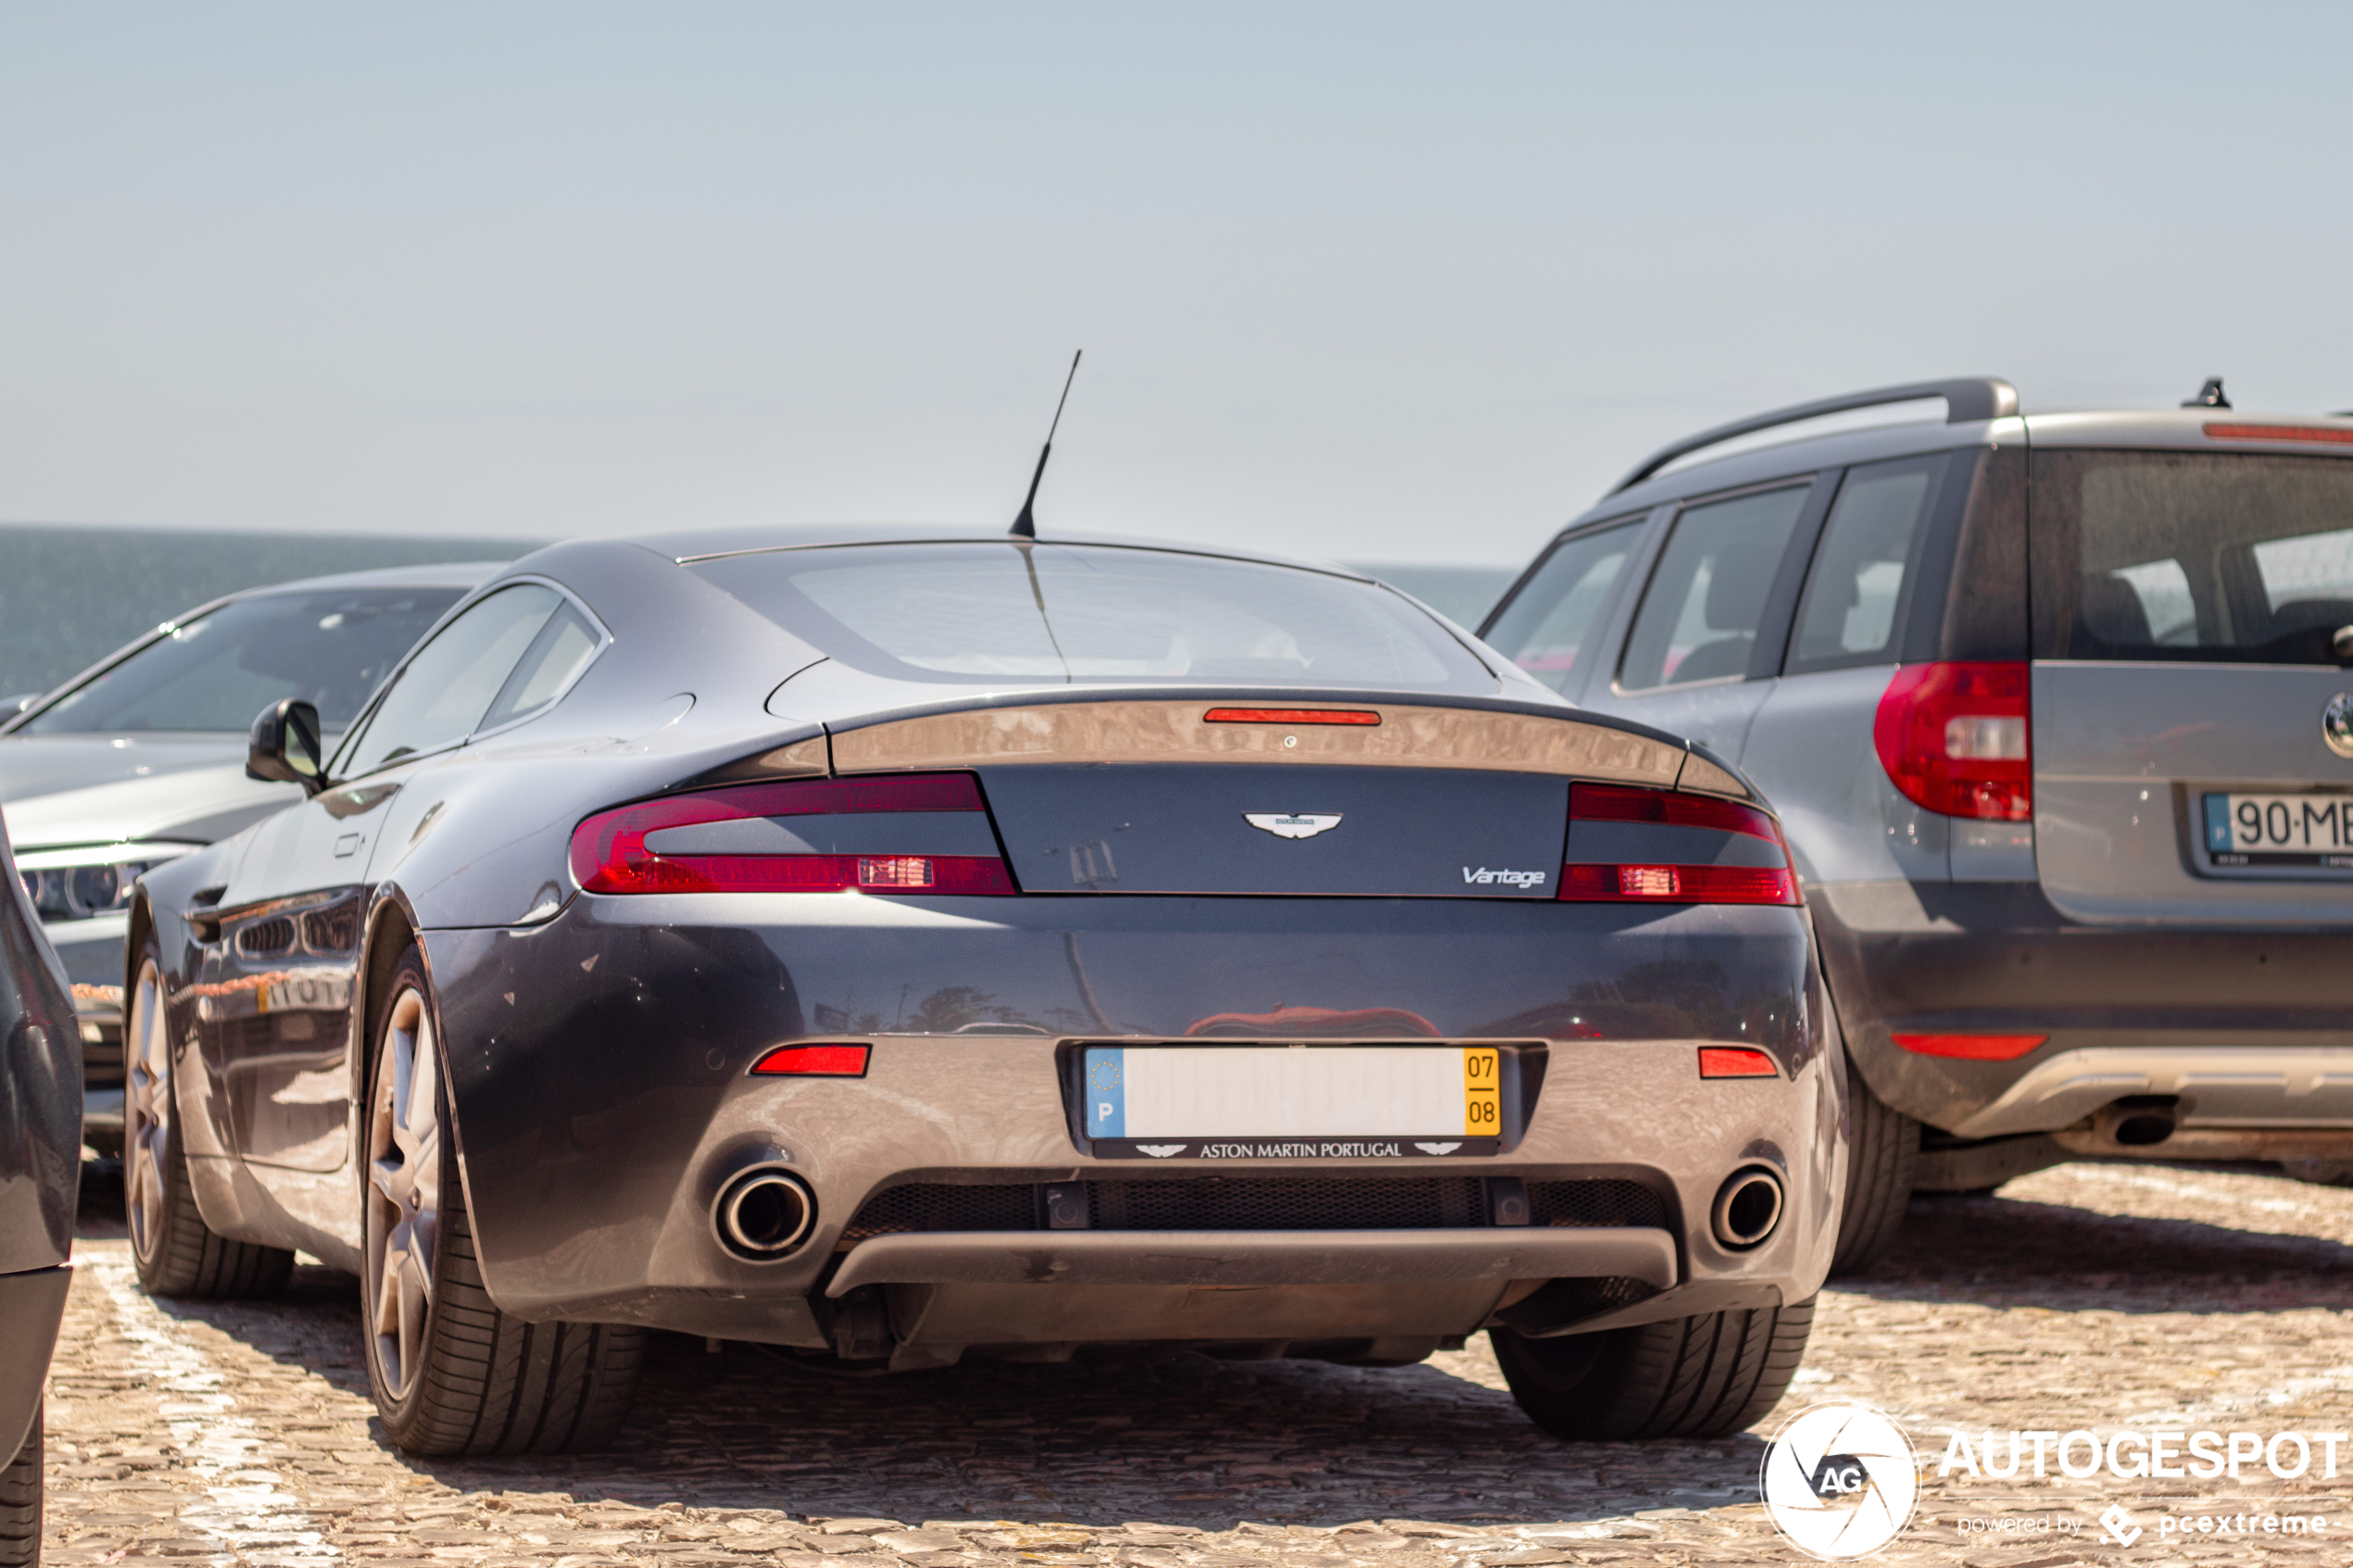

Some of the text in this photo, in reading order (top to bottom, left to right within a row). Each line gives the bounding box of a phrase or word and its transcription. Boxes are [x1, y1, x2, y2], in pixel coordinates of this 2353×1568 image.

[1463, 867, 1545, 888] Vantage
[1468, 1056, 1493, 1078] 07
[1099, 1103, 1114, 1122] P
[1469, 1101, 1494, 1123] 08
[1200, 1143, 1403, 1158] ASTON MARTIN PORTUGAL
